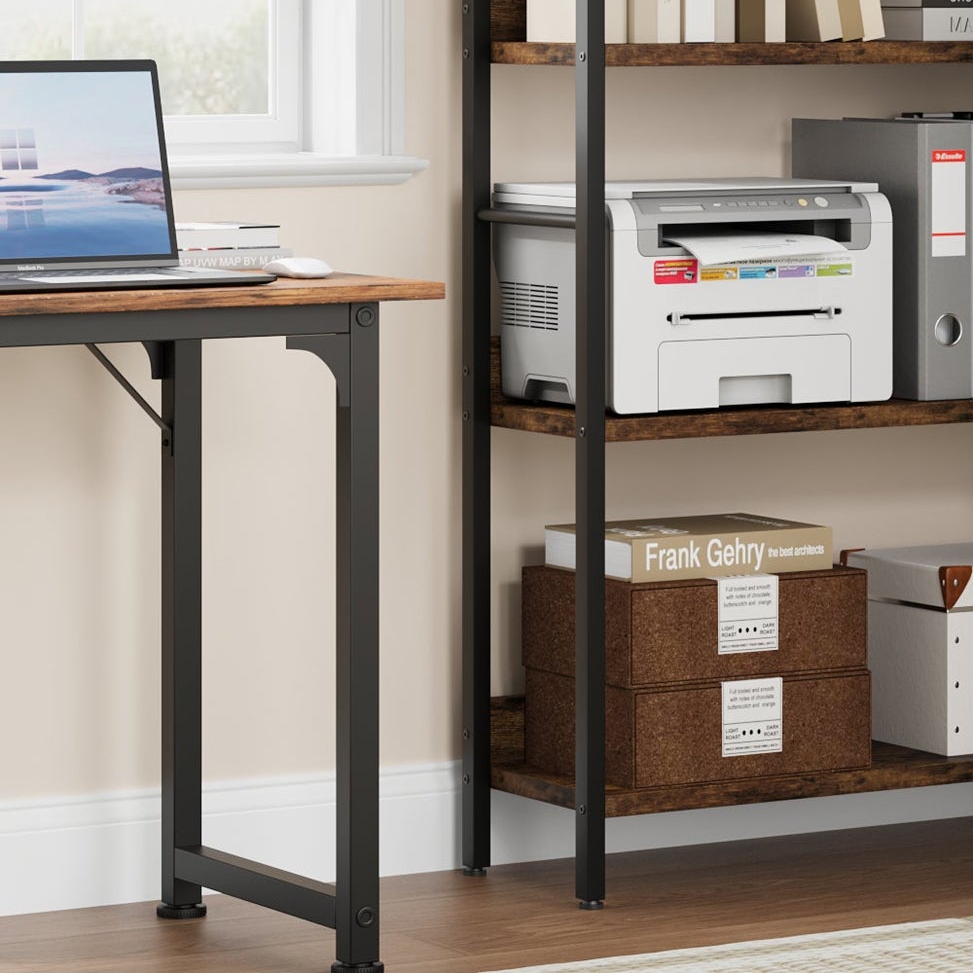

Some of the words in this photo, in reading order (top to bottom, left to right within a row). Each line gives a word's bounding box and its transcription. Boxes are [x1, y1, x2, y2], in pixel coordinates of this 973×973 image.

[179, 258, 192, 267] AP
[193, 257, 217, 267] UVW
[219, 257, 241, 267] MAP
[243, 257, 257, 266] BY
[645, 542, 700, 571] Frank
[706, 537, 765, 570] Gehry
[768, 547, 778, 558] the
[778, 546, 793, 557] best
[793, 543, 825, 556] architects
